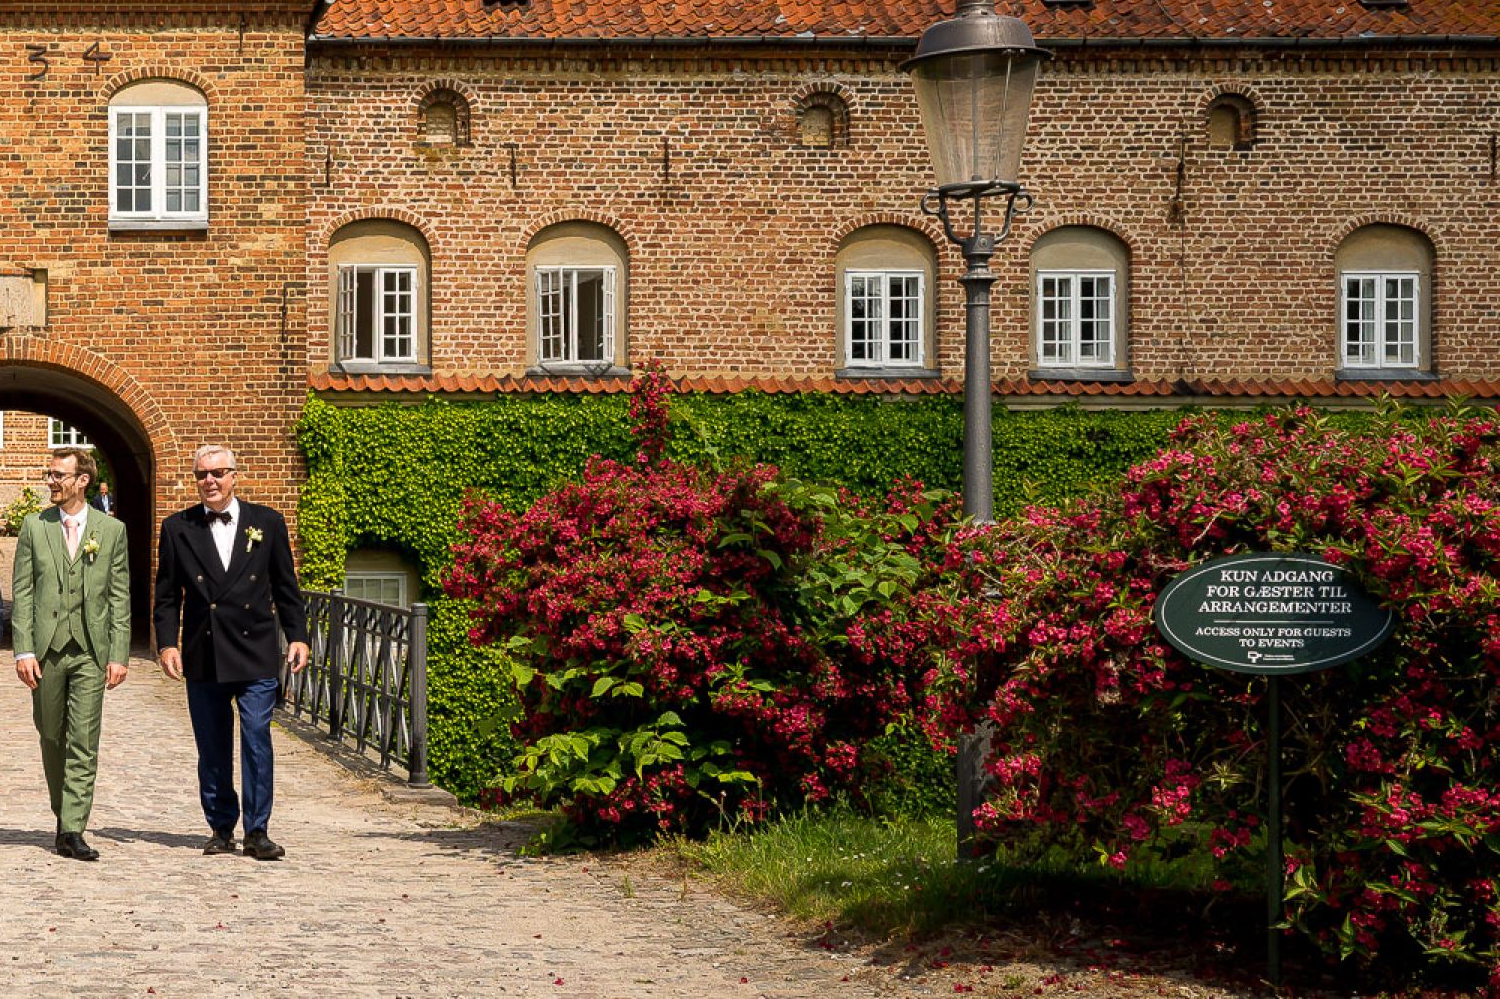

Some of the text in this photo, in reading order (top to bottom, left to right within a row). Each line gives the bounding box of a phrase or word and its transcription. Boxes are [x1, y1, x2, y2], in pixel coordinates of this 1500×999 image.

[1221, 570, 1333, 582] KUN ADGANG
[1206, 585, 1347, 598] FOR GÆSTER TIL
[1198, 601, 1352, 613] ARRANGEMENTER
[1195, 628, 1351, 636] ACCESS ONLY FOR GUESTS
[1239, 639, 1304, 647] TO EVENTS
